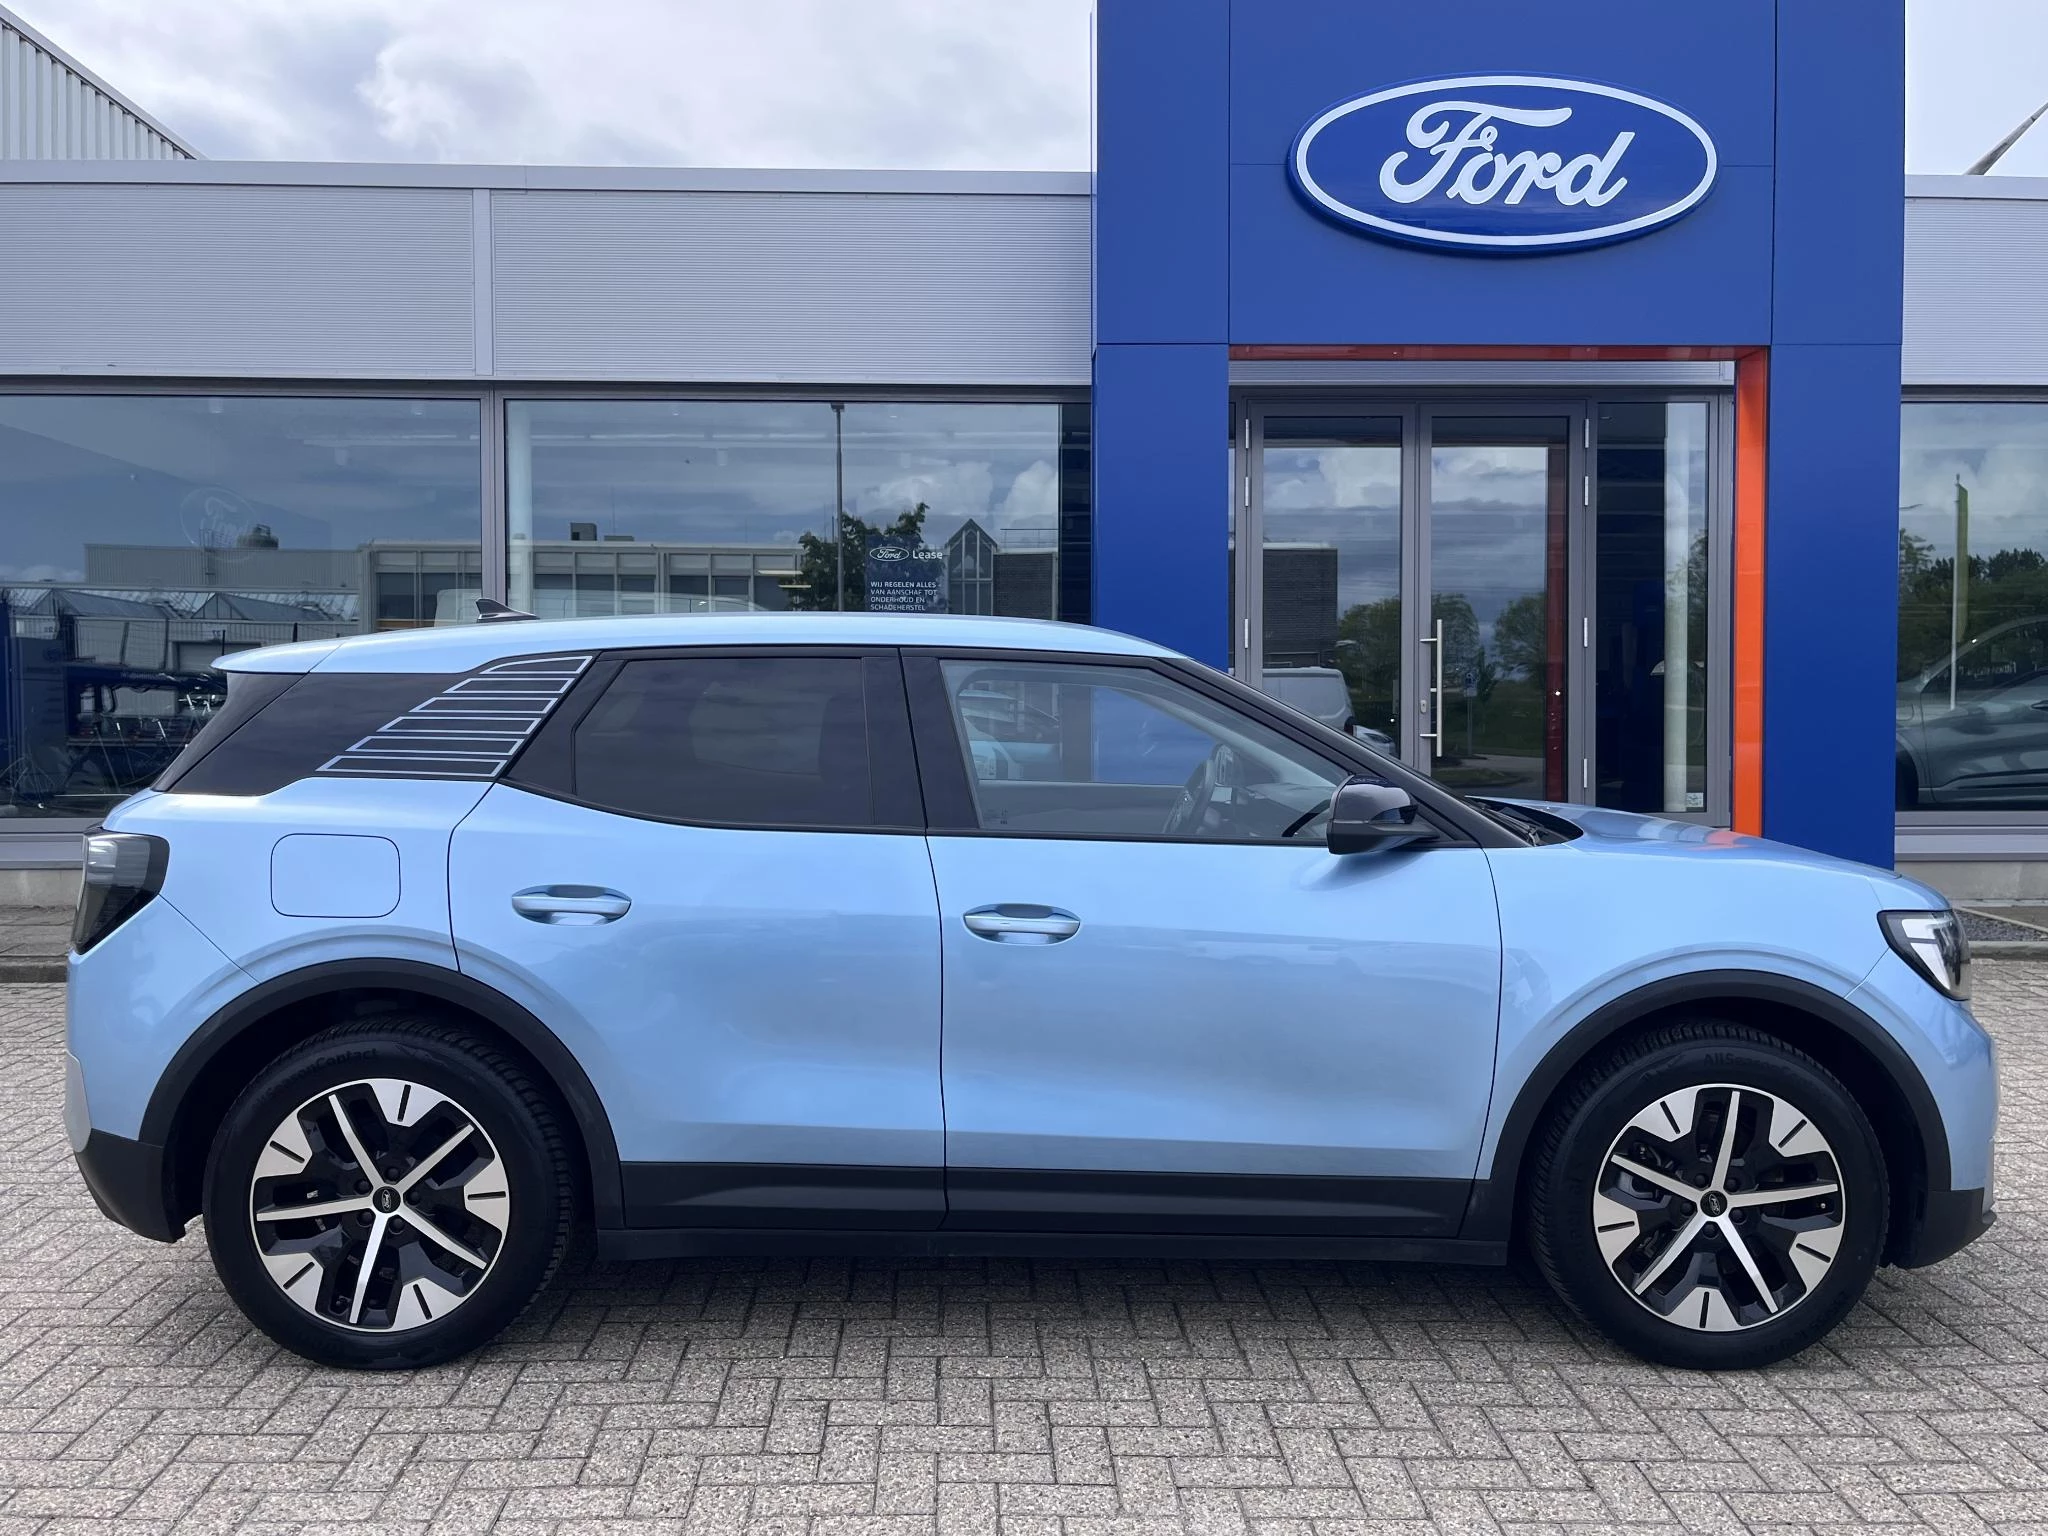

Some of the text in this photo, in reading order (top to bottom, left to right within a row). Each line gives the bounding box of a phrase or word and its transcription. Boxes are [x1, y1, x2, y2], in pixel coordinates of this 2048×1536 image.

[1380, 100, 1636, 207] Ford
[877, 548, 943, 559] Ford Lease
